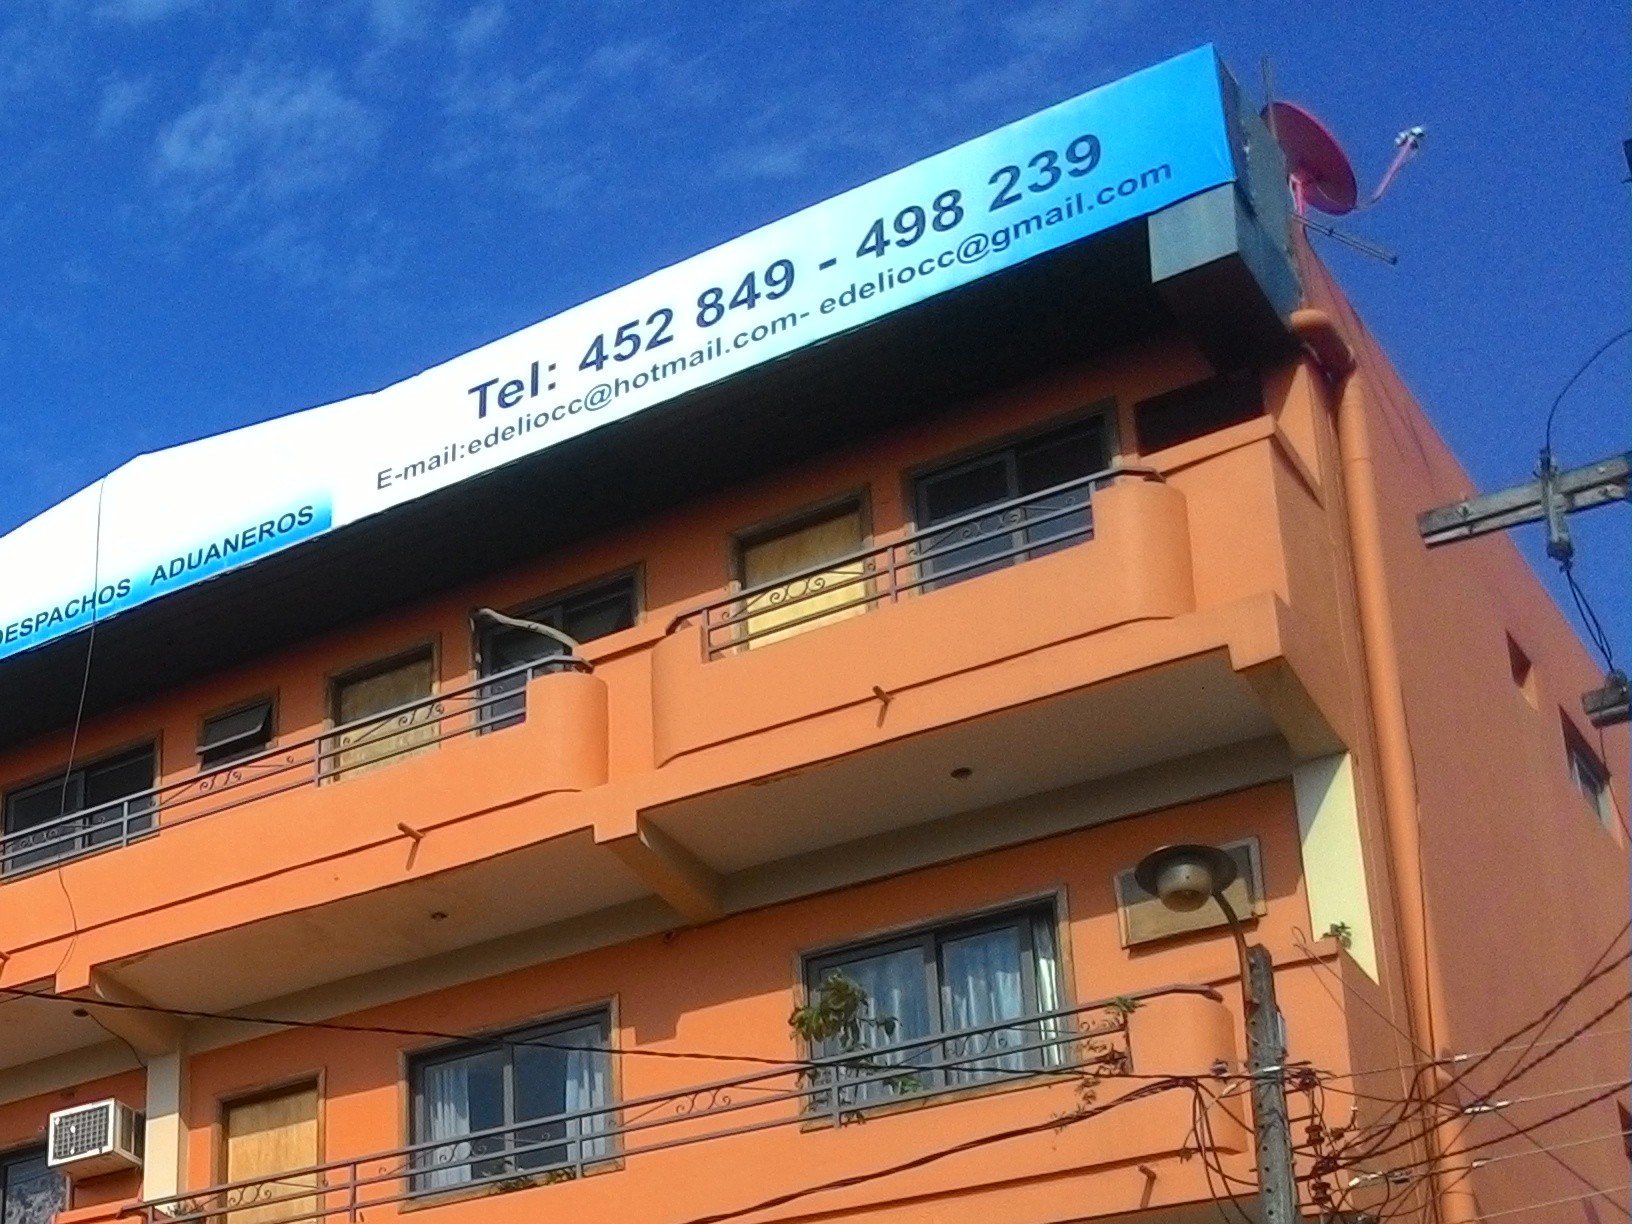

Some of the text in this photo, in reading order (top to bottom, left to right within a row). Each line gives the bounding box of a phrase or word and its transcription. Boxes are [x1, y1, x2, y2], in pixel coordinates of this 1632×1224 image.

[467, 360, 557, 419] Tel:
[578, 307, 675, 373] 452
[695, 258, 795, 329] 849
[855, 188, 965, 259] 498
[987, 133, 1103, 213] 239
[819, 161, 1173, 315] edeliocc@gmail.com
[149, 505, 314, 587] ADUANEROS
